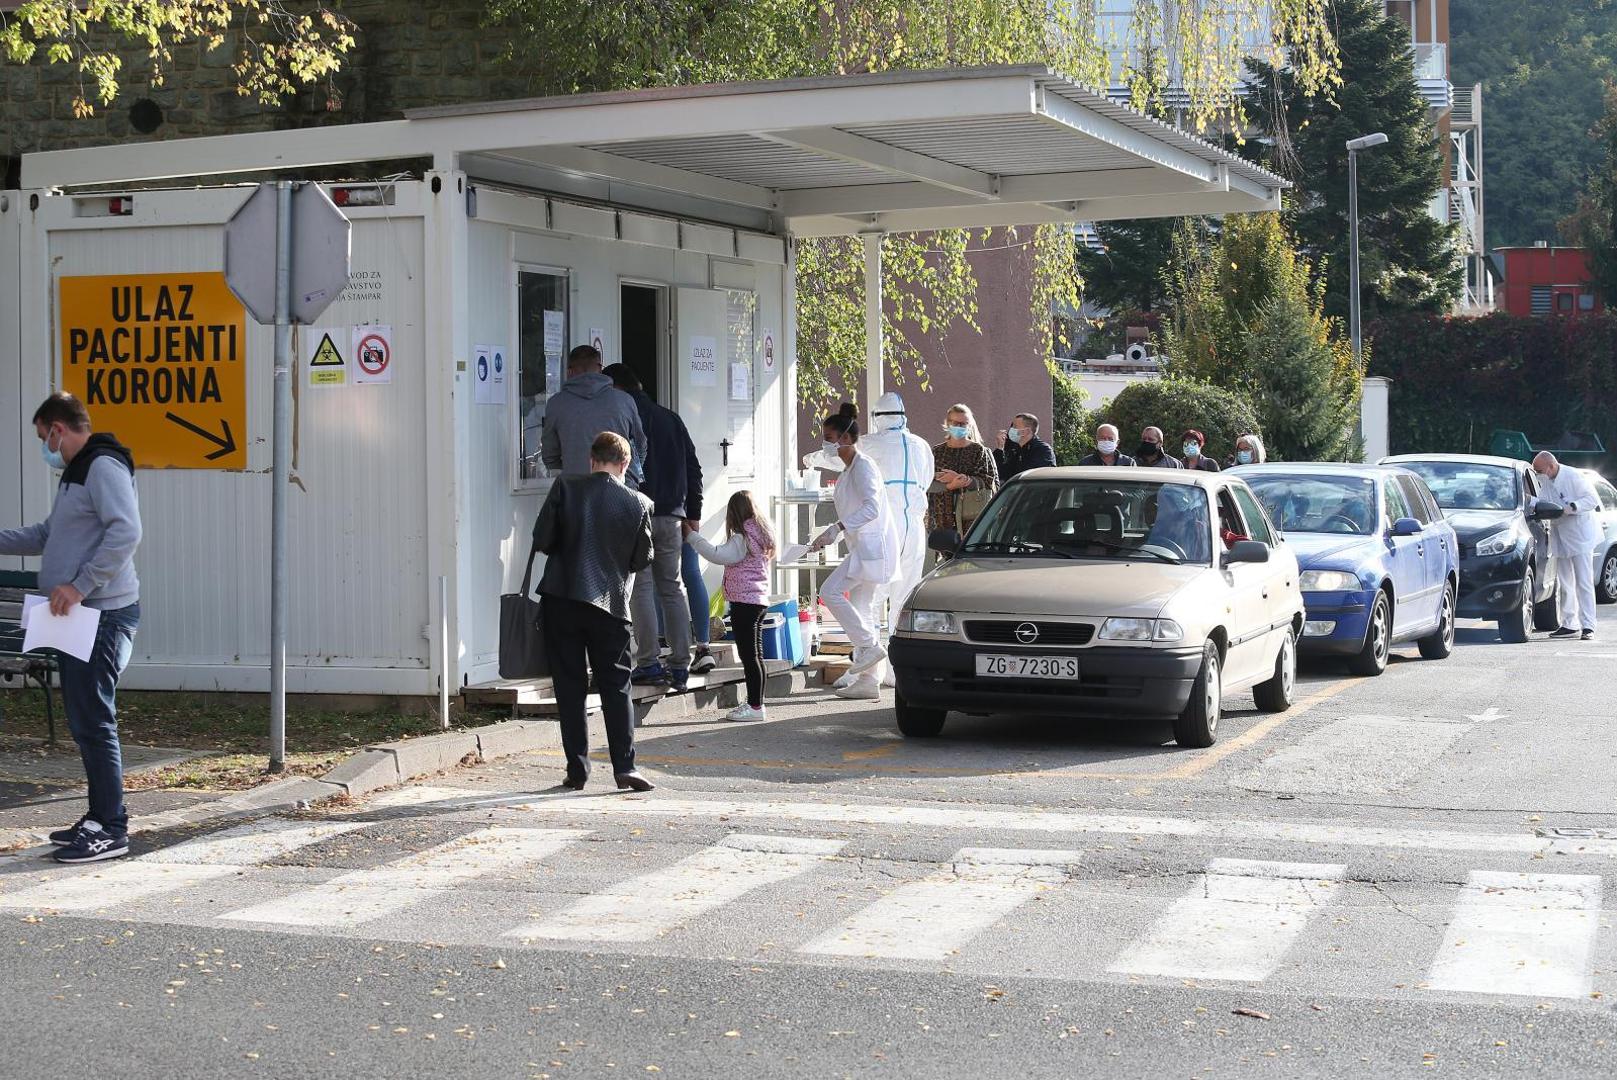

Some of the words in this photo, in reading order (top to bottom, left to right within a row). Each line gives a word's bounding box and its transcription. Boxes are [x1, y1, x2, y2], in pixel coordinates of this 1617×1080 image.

[345, 282, 382, 290] AVSTVO
[350, 271, 369, 279] VOD
[111, 284, 194, 323] ULAZ
[70, 325, 237, 365] PACIJENTI
[86, 366, 222, 405] KORONA
[986, 657, 1007, 674] ZG
[1018, 658, 1076, 676] 7230-S
